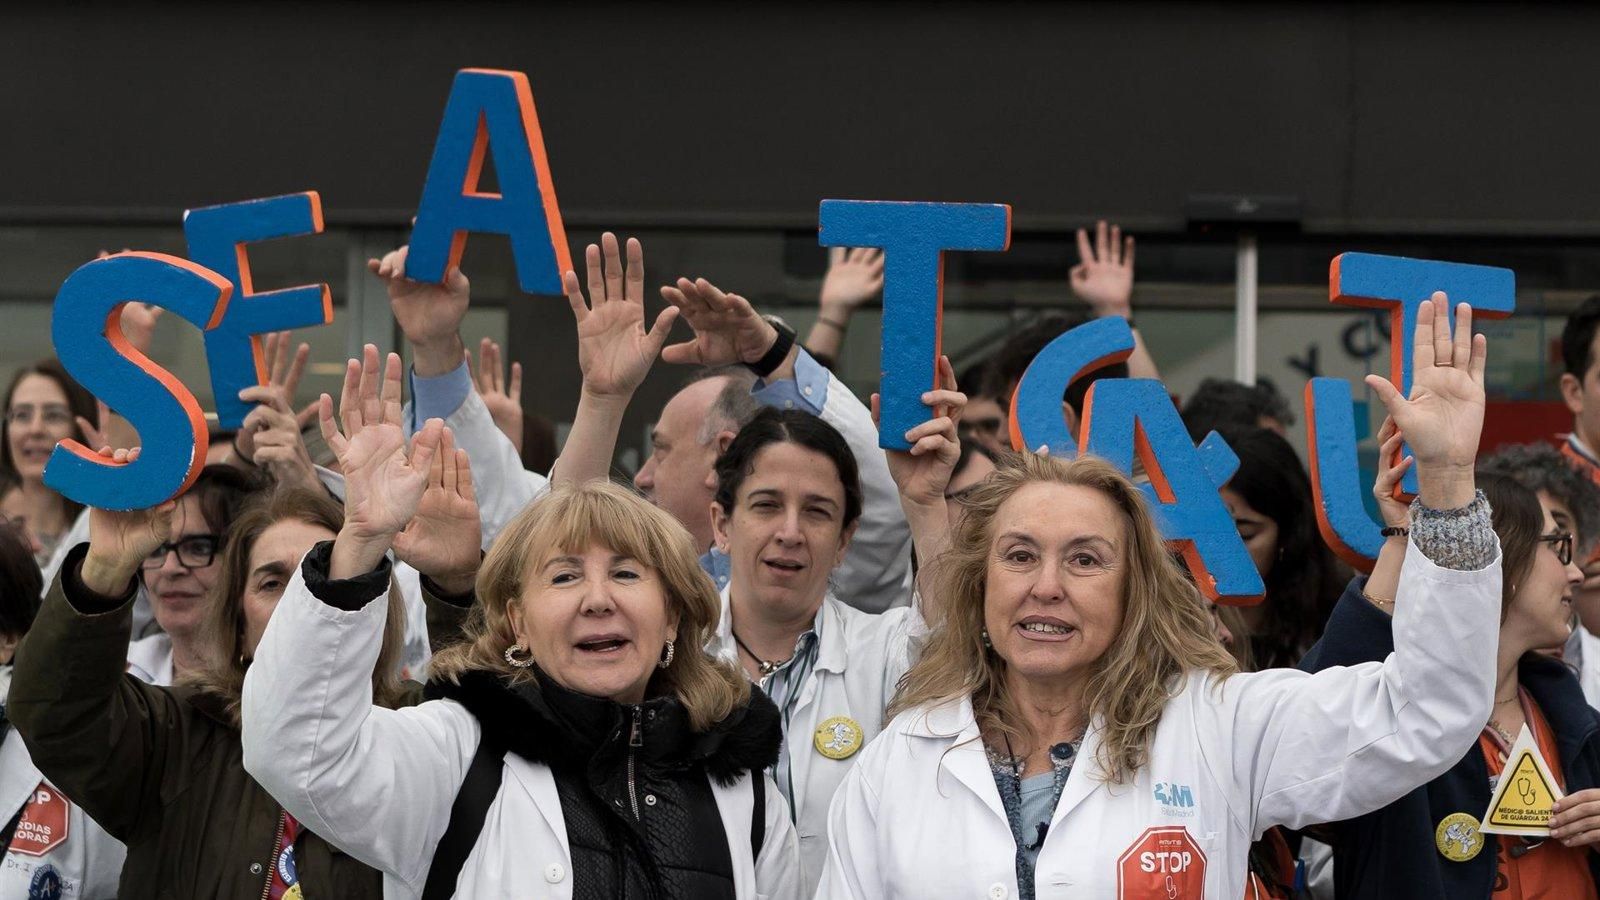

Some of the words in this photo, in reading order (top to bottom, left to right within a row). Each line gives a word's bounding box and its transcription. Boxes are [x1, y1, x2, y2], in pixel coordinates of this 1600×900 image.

[404, 67, 571, 297] A
[42, 250, 233, 511] S
[183, 190, 333, 429] F
[818, 198, 1012, 451] T
[1329, 251, 1516, 502] T
[1078, 378, 1267, 607] A
[1140, 851, 1191, 873] STOP
